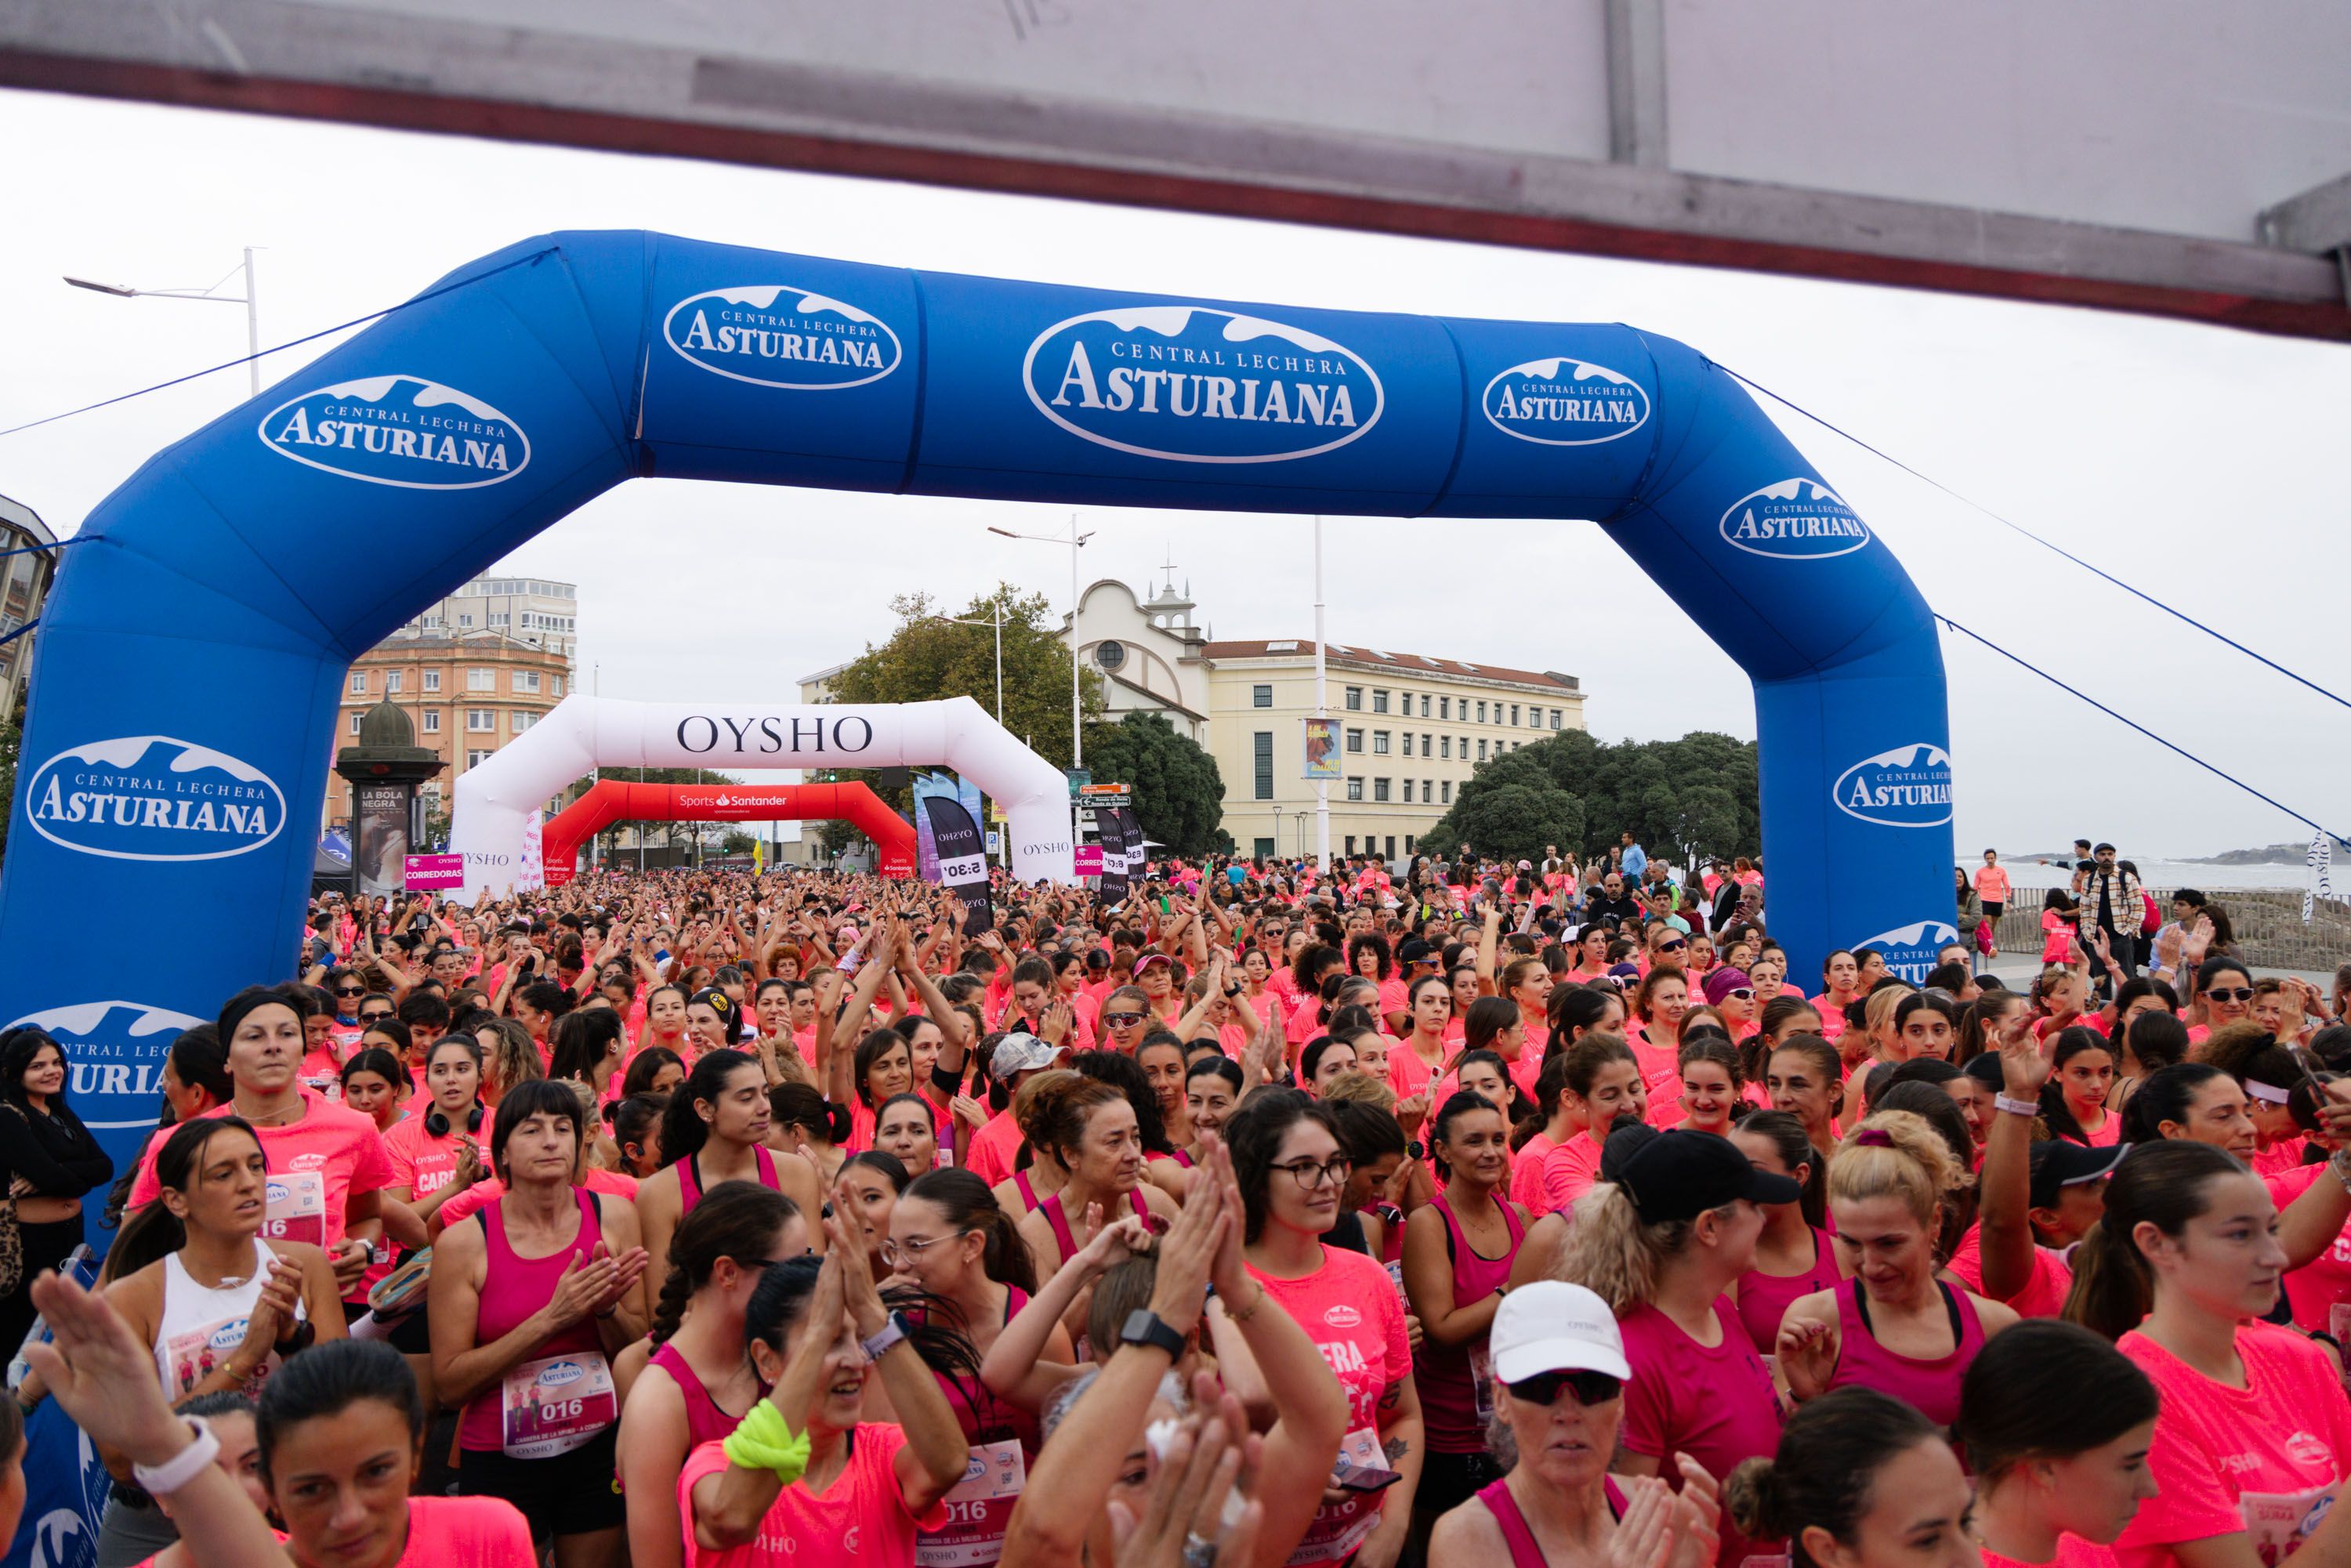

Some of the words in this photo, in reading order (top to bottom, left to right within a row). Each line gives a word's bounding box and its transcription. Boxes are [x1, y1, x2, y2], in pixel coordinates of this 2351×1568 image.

[722, 310, 796, 328] CENTRAL
[804, 320, 877, 337] LECHERA
[682, 309, 885, 369] ASTURIANA
[1111, 342, 1225, 366] CENTRAL
[1237, 353, 1346, 375] LECHERA
[1051, 341, 1357, 427] ASTURIANA
[1523, 384, 1575, 394] CENTRAL
[1581, 386, 1632, 396] LECHERA
[1495, 384, 1638, 423] ASTURIANA
[324, 406, 410, 422] CENTRAL
[420, 415, 506, 438] LECHERA
[275, 407, 509, 472] ASTURIANA
[1765, 505, 1814, 514] CENTRAL
[1733, 508, 1865, 539] ASTURIANA
[677, 716, 872, 753] OYSHO
[1877, 773, 1928, 782] CENTRAL
[75, 773, 166, 791] CENTRAL
[176, 782, 265, 799] LECHERA
[36, 773, 268, 835] ASTURIANA
[679, 795, 715, 809] Sports
[731, 795, 787, 806] Santander
[1023, 842, 1070, 856] OYSHO
[406, 870, 462, 880] CORREDORAS
[1884, 951, 1936, 960] CENTRAL
[713, 995, 727, 1010] Buff
[1650, 1068, 1673, 1080] OYSHO
[416, 1153, 446, 1164] OYSHO
[542, 1370, 581, 1382] ASTURIANA
[542, 1398, 583, 1421] 016
[515, 1435, 541, 1444] CARRERA
[516, 1443, 552, 1455] OYSHO
[922, 1551, 958, 1560] OYSHO
